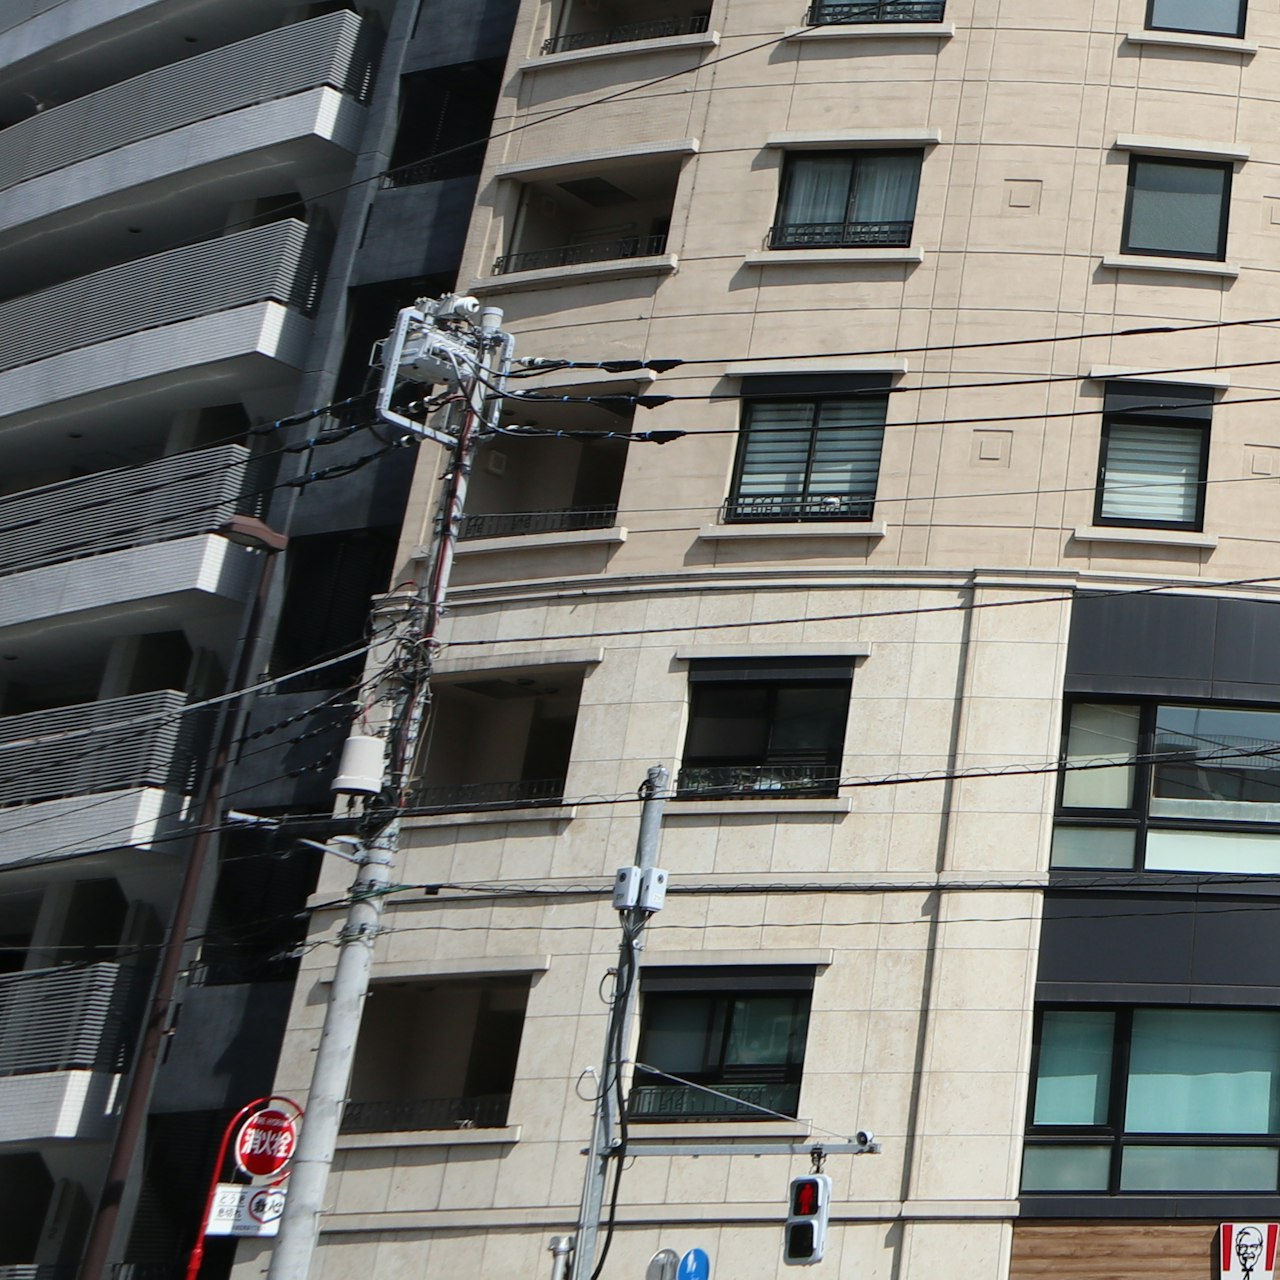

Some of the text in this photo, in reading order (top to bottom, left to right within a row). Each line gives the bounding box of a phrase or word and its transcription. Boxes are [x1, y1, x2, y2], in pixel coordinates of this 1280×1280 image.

[241, 1127, 292, 1157] 消火栓
[219, 1193, 246, 1205] どうき
[253, 1198, 283, 1215] 救心
